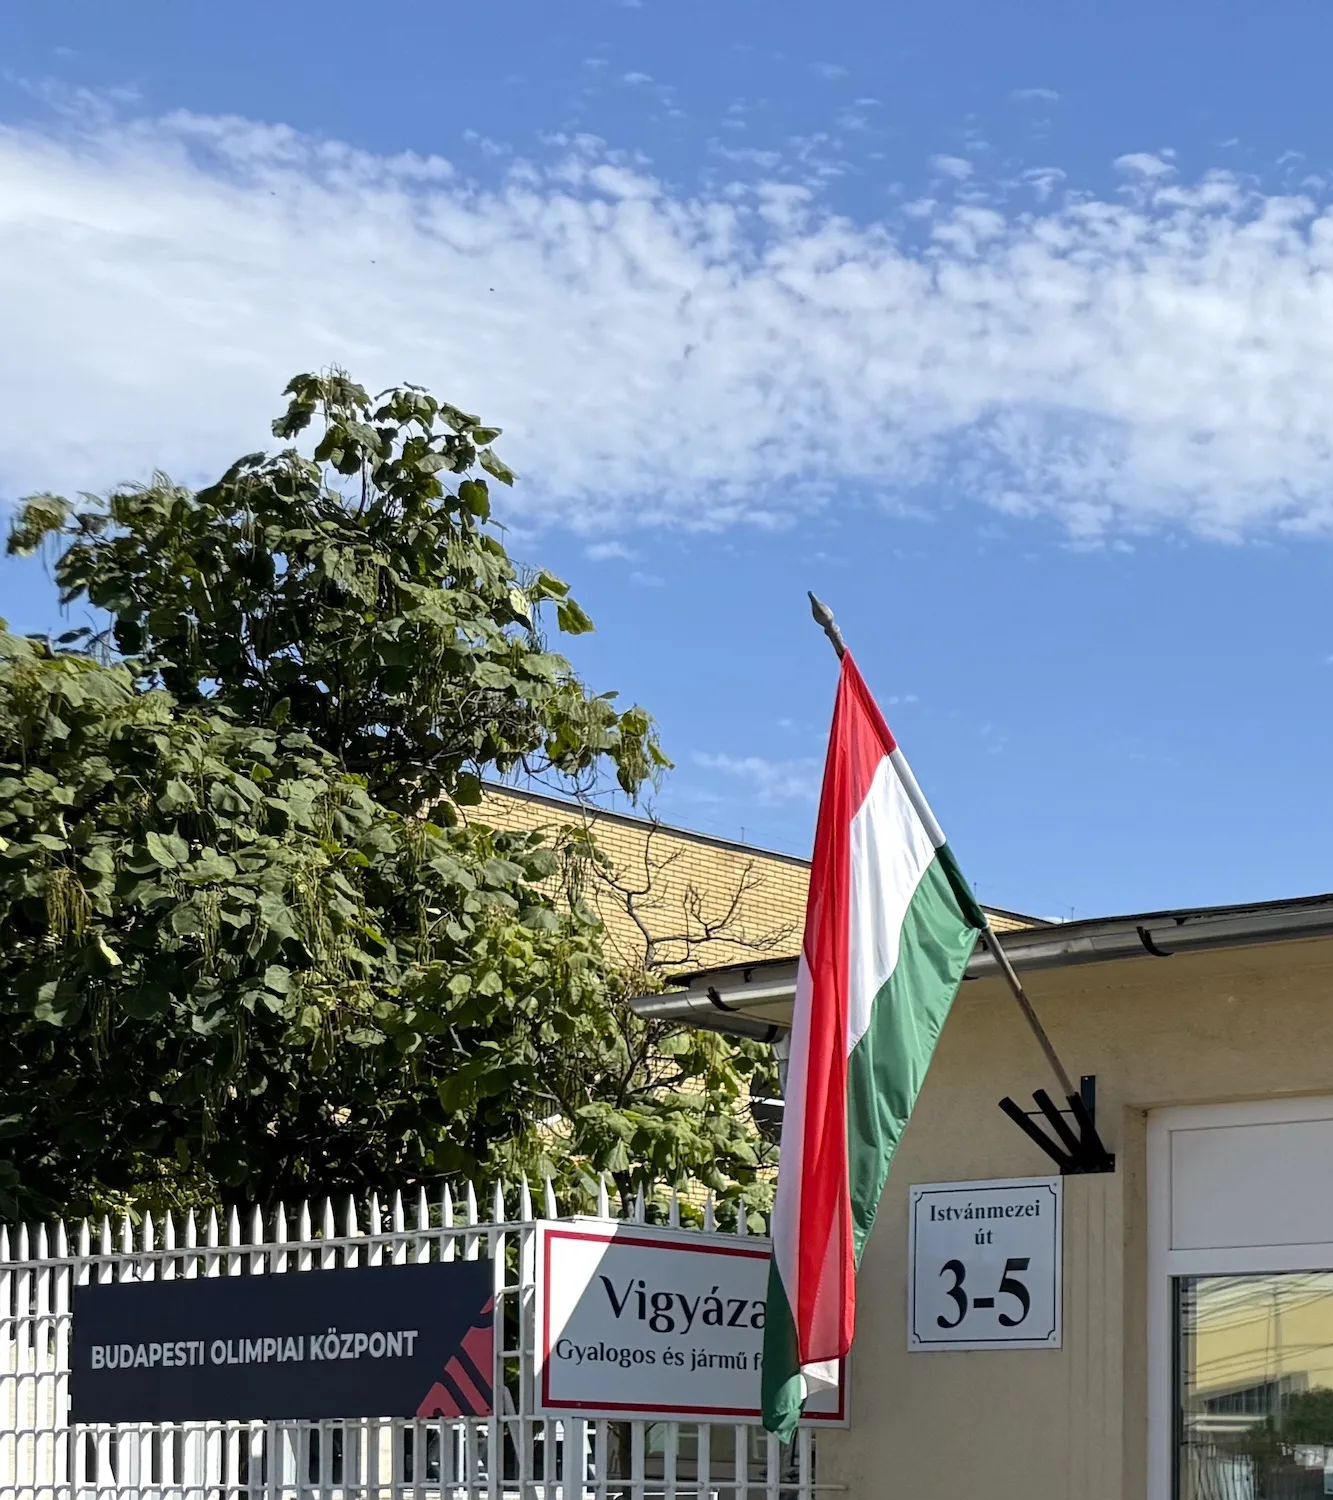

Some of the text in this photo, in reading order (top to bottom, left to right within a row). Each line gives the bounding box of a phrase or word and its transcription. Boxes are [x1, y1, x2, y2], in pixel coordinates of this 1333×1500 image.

[930, 1199, 1040, 1222] Istvánmezei
[974, 1228, 994, 1245] út
[936, 1257, 1032, 1329] 3-5
[91, 1327, 419, 1369] BUDAPESTI OLIMPIAI KÖZPONT
[555, 1338, 656, 1369] Gyalogos
[662, 1346, 685, 1366] és
[690, 1348, 747, 1371] jármű
